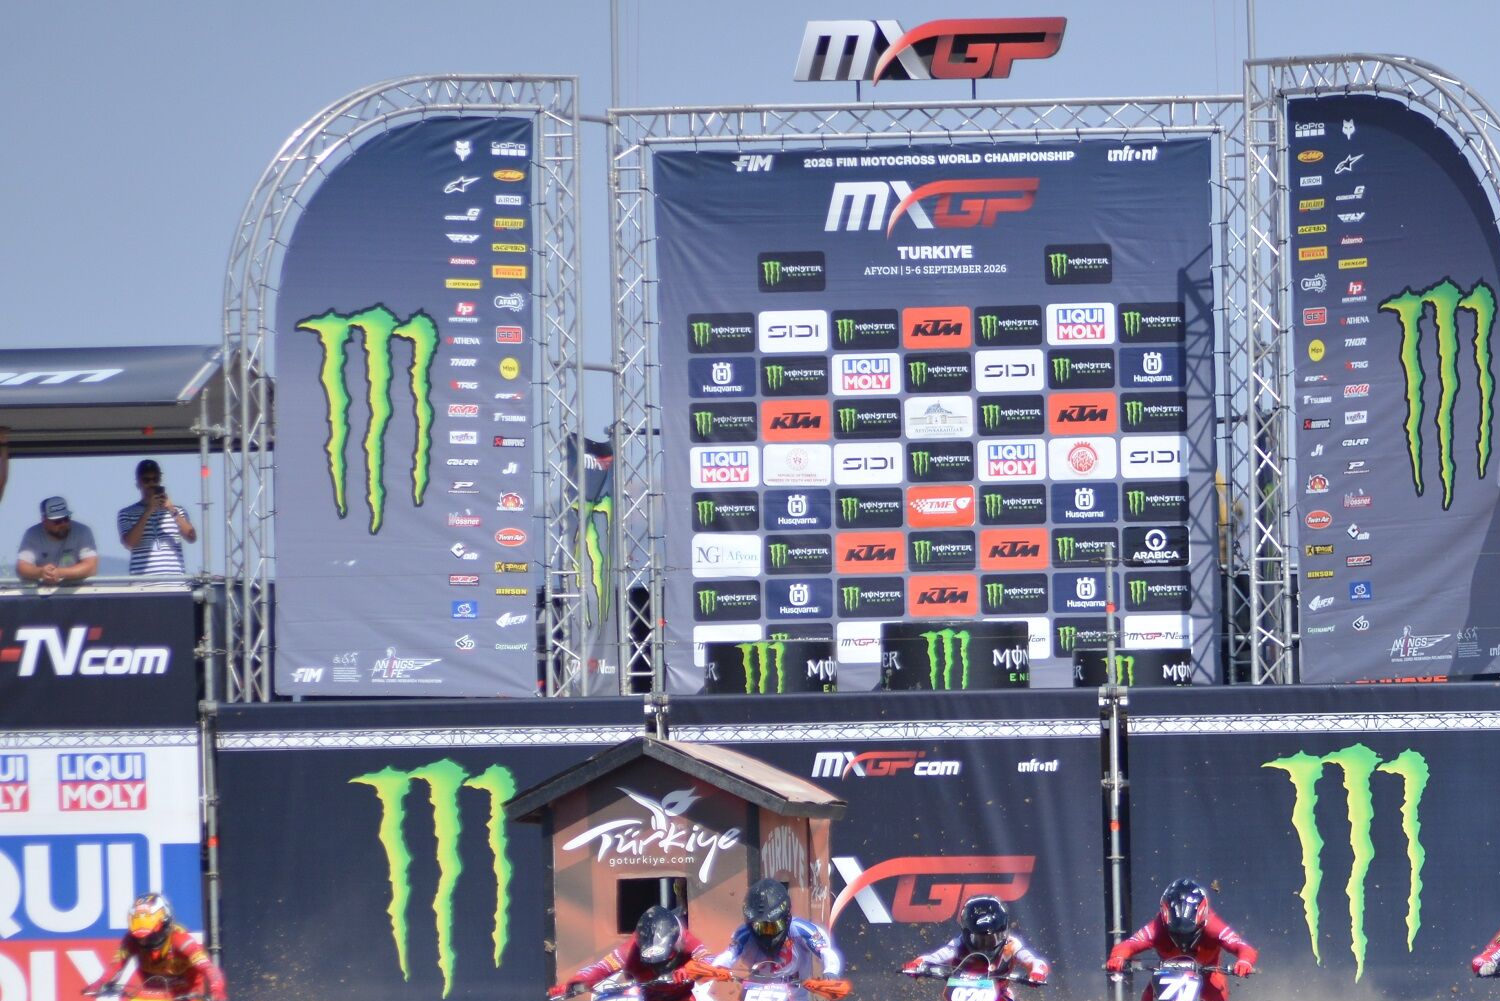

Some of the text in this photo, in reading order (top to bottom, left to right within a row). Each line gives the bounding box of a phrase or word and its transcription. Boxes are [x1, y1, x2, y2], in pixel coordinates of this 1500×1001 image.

[794, 16, 1067, 87] MXGP
[1295, 123, 1325, 131] GoPro
[491, 142, 526, 150] GoPro
[731, 155, 773, 172] FIM
[804, 151, 1075, 168] 2026 FIM MOTOCROSS WORLD CHAMPIONSHIP
[824, 178, 1040, 240] MXGP
[898, 246, 973, 260] TURKIYE
[864, 264, 1007, 276] AFYON 5-6 SEPTEMBER 2026
[1059, 309, 1103, 324] LIQUI
[1142, 316, 1181, 324] MONSTER
[1346, 316, 1370, 324] ATHENA
[855, 323, 895, 331] MONSTER
[911, 319, 962, 337] KTM
[999, 319, 1039, 327] MONSTER
[768, 324, 819, 338] SIDI
[1059, 325, 1104, 340] MOLY
[453, 337, 480, 345] ATHENA
[1345, 338, 1367, 347] THOR
[784, 369, 825, 377] MONSTER
[843, 360, 889, 374] LIQUI
[984, 364, 1035, 377] SIDI
[843, 375, 890, 390] MOLY
[1134, 374, 1172, 383] Husqvarna
[703, 385, 742, 393] Husqvarna
[1001, 409, 1041, 417] MONSTER
[1057, 405, 1108, 423] KTM
[1144, 406, 1184, 414] MONSTER
[714, 416, 753, 424] MONSTER
[770, 412, 821, 430] KTM
[857, 413, 897, 421] MONSTER
[989, 445, 1035, 460] LIQUI
[1130, 450, 1181, 464] SIDI
[702, 452, 747, 466] LIQUI
[843, 457, 894, 471] SIDI
[989, 461, 1036, 476] MOLY
[702, 468, 748, 483] MOLY
[859, 502, 899, 510] MONSTER
[1003, 498, 1042, 506] MONSTER
[715, 506, 755, 514] MONSTER
[1066, 511, 1104, 519] Husqvarna
[778, 517, 816, 526] Husqvarna
[1307, 516, 1320, 524] Twin
[788, 548, 828, 556] MONSTER
[845, 544, 896, 561] KTM
[932, 544, 972, 552] MONSTER
[989, 541, 1040, 558] KTM
[1133, 551, 1179, 560] ARABICA
[717, 594, 757, 602] MONSTER
[861, 591, 901, 599] MONSTER
[917, 587, 969, 603] KTM
[780, 606, 818, 615] Husqvarna
[1067, 600, 1105, 609] Husqvarna
[290, 668, 325, 682] FIM
[61, 755, 144, 781] LIQUI
[62, 784, 145, 810] MOLY
[562, 818, 741, 884] Türkiye
[609, 854, 695, 867] goturkiye.com
[828, 855, 1036, 933] XGP
